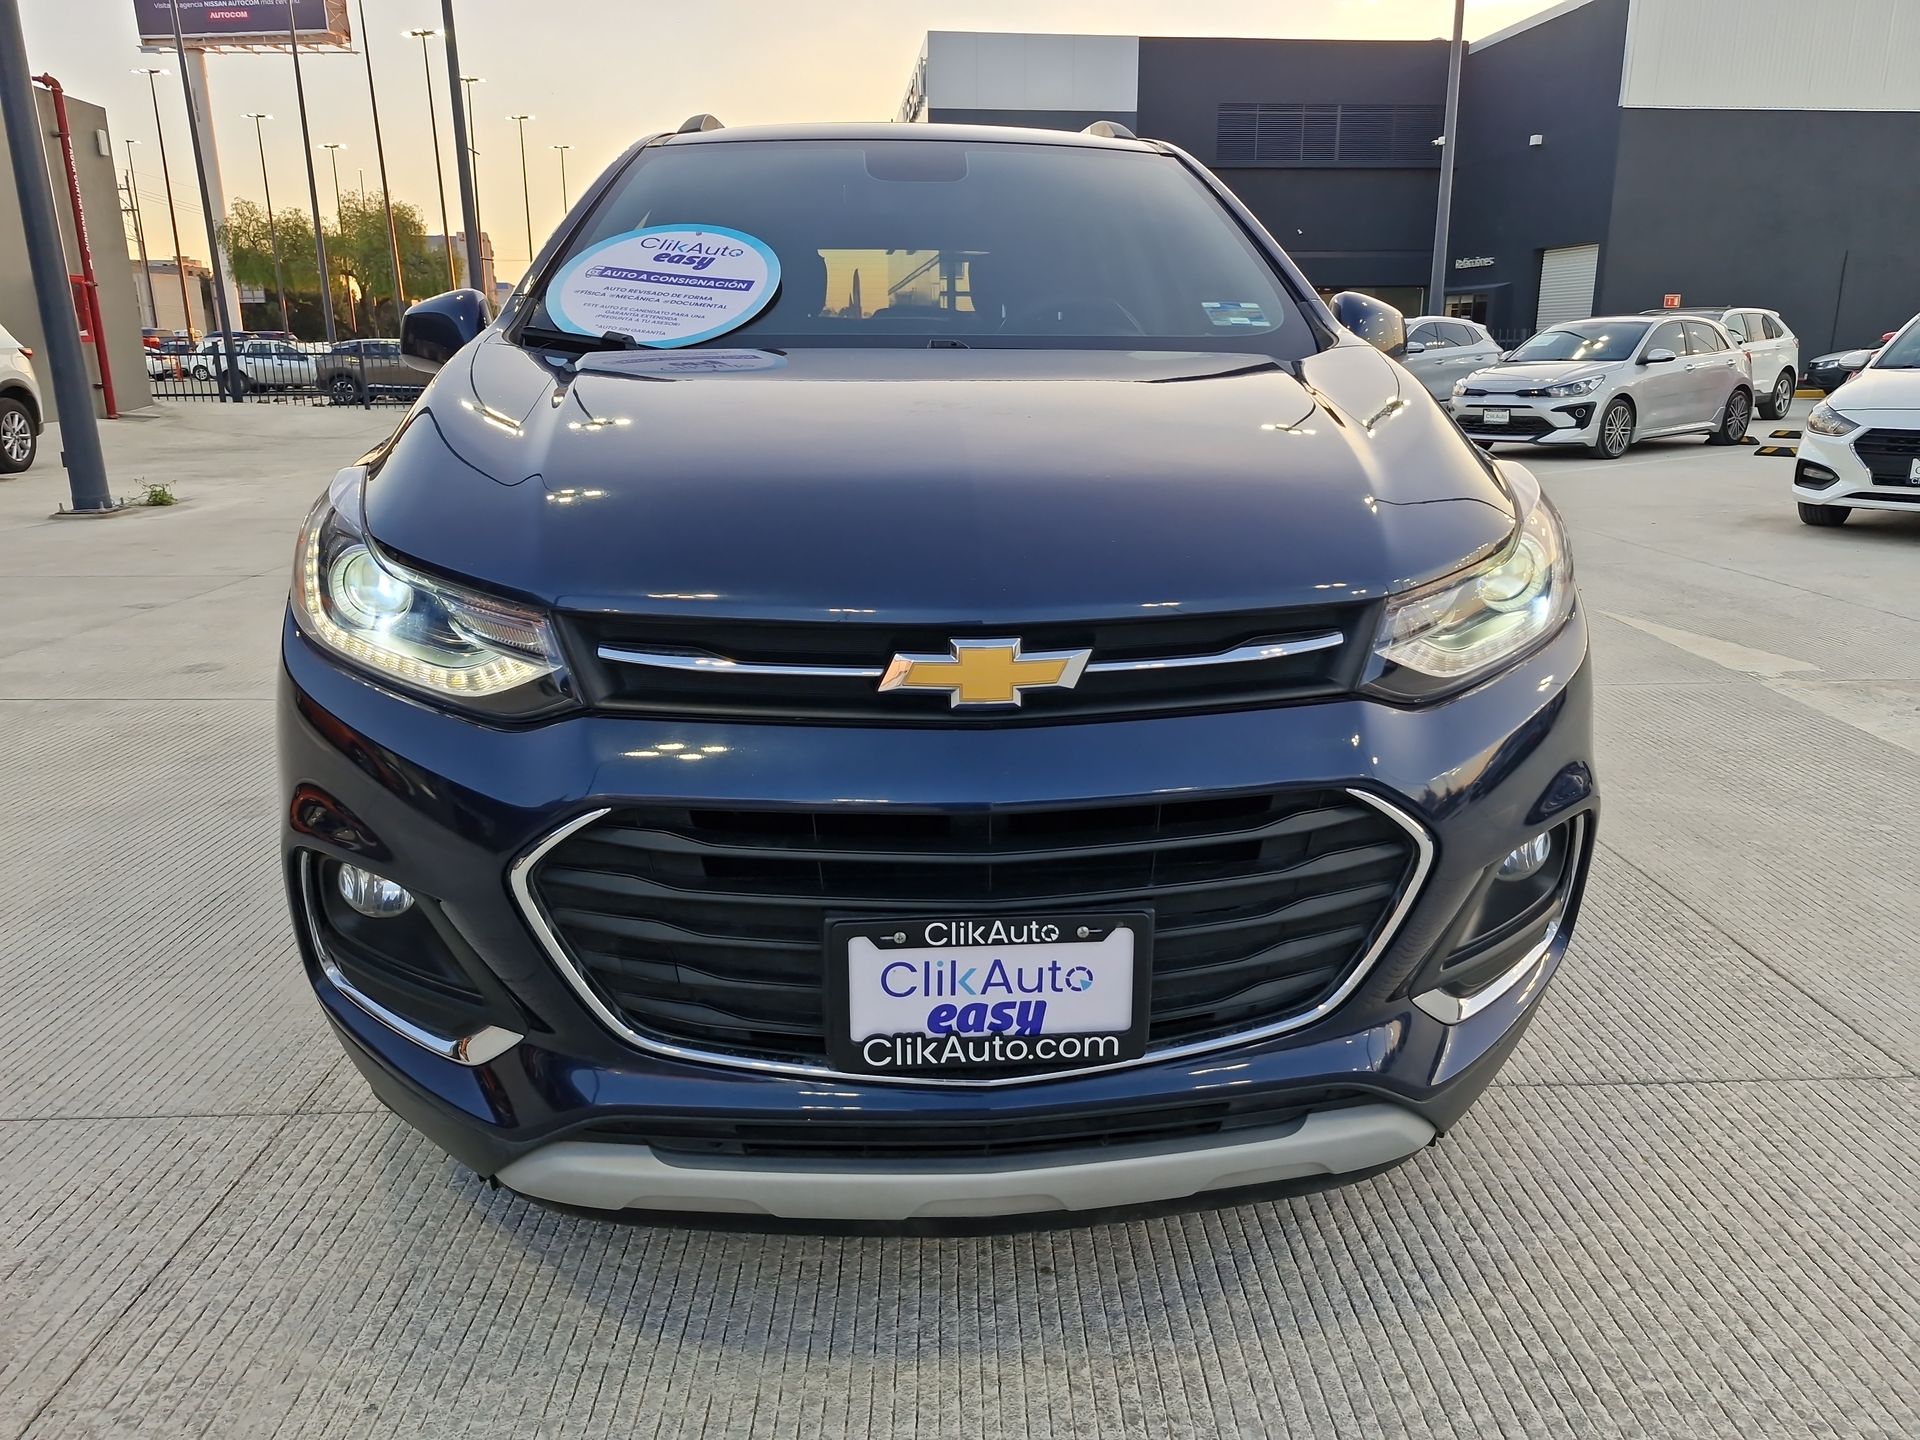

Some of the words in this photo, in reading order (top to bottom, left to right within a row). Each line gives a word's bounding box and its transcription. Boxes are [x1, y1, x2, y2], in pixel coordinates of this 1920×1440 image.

[209, 11, 248, 19] AUTOCOM
[640, 237, 744, 258] ClikAuto
[653, 252, 716, 271] easy
[602, 269, 638, 279] AUTO
[650, 274, 748, 289] CONSIGNACIÓN
[628, 288, 670, 297] REVISADO
[629, 307, 670, 316] CANDIDATO
[924, 920, 1060, 946] ClikAuto
[880, 958, 1094, 998] ClikAuto
[926, 999, 1048, 1036] easy
[862, 1034, 1120, 1067] ClikAuto.com
